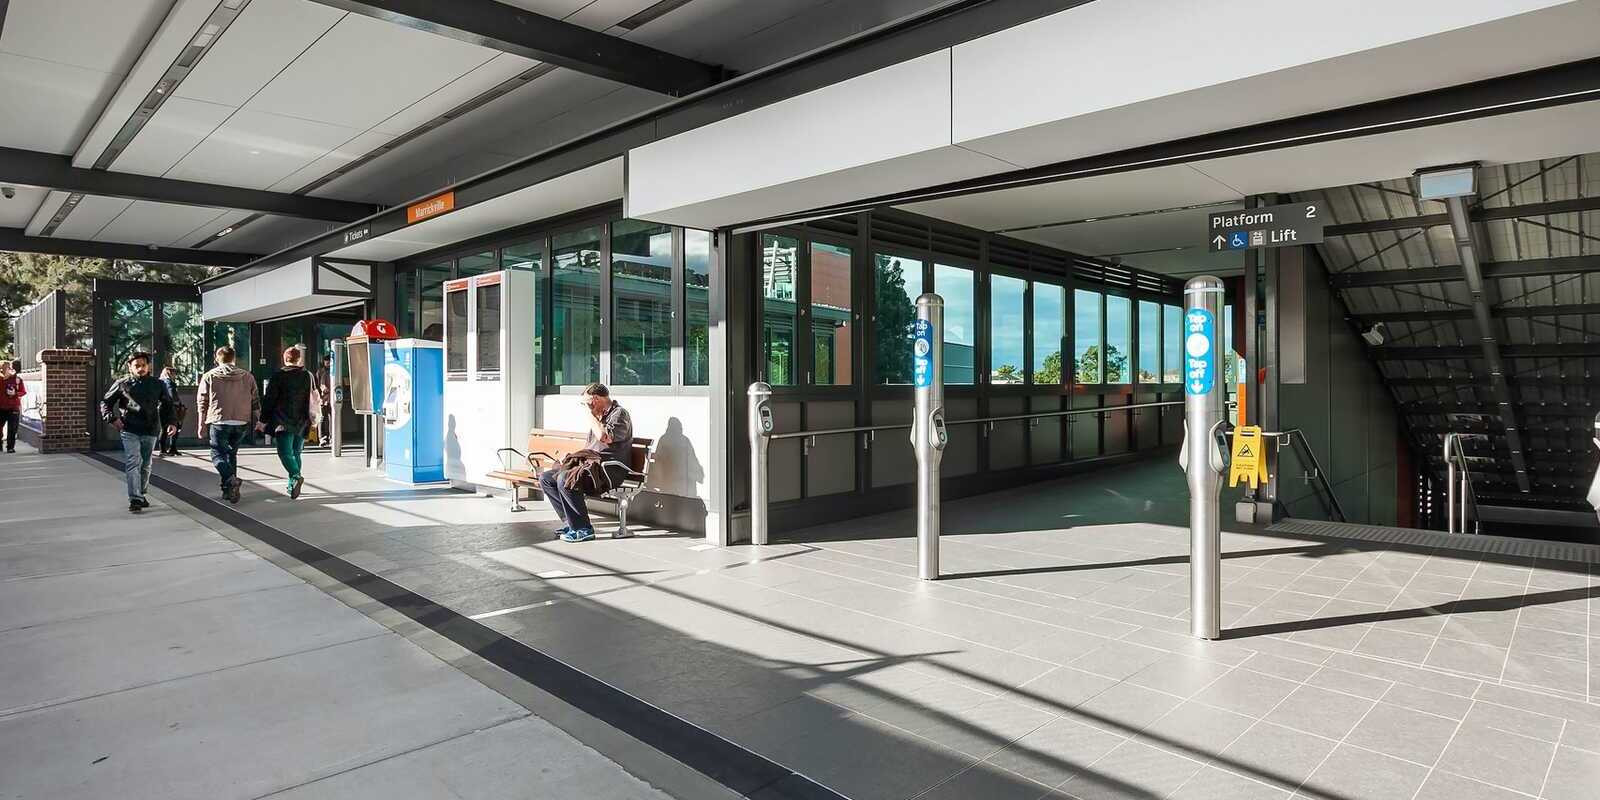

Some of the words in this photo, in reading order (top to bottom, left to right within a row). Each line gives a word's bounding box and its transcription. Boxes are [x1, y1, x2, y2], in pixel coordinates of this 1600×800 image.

[415, 200, 446, 217] Marrickville
[1212, 212, 1274, 229] Platform
[1305, 205, 1317, 218] 2
[1271, 229, 1297, 243] Lift
[1187, 314, 1207, 324] Tap
[916, 322, 928, 331] Tap
[1188, 358, 1207, 369] Tap
